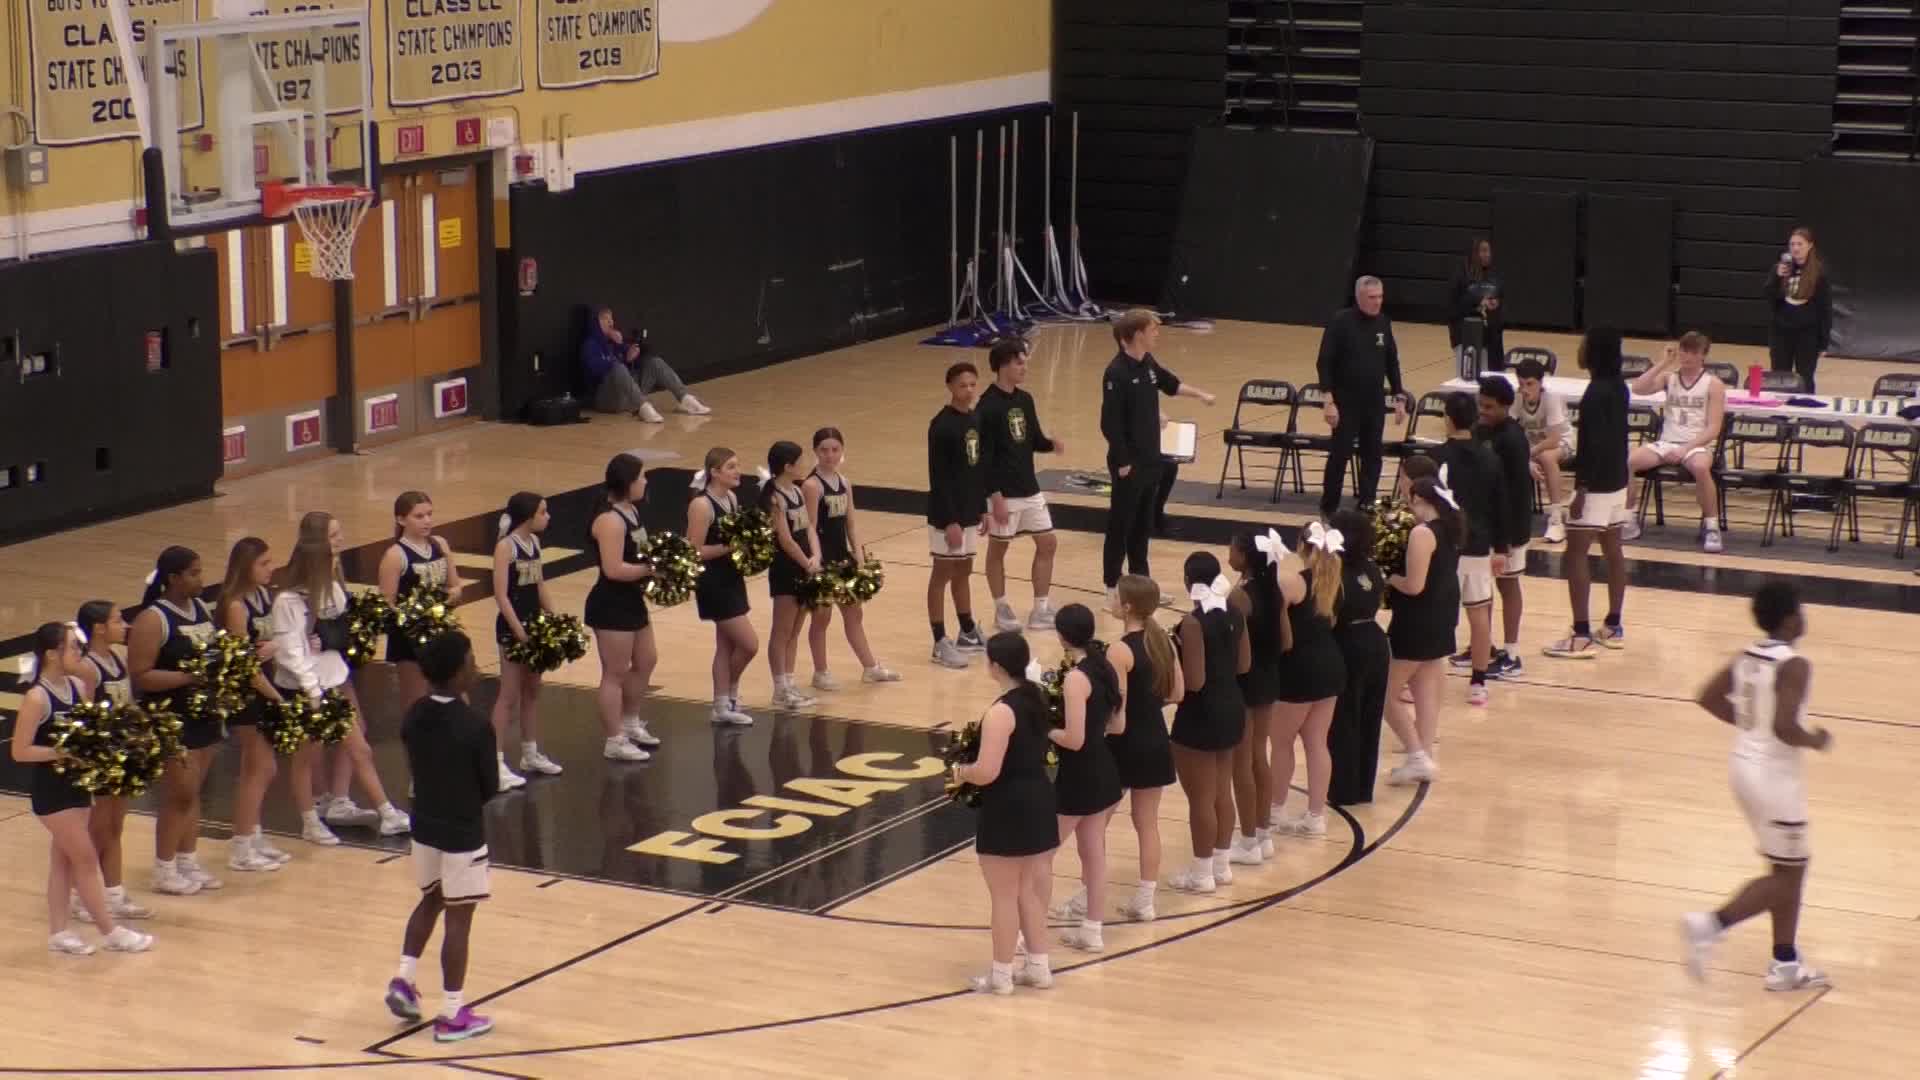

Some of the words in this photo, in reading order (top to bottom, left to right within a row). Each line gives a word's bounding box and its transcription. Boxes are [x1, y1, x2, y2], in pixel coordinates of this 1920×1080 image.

[64, 21, 145, 46] CLAS
[398, 27, 437, 56] STATE
[443, 20, 512, 52] CHAMPIONS
[548, 15, 582, 41] STATE
[588, 8, 652, 37] CHAMPIONS
[284, 33, 360, 67] CHAPIONS
[579, 47, 621, 70] 2019
[48, 59, 97, 90] STATE
[624, 752, 947, 865] FCIAC
